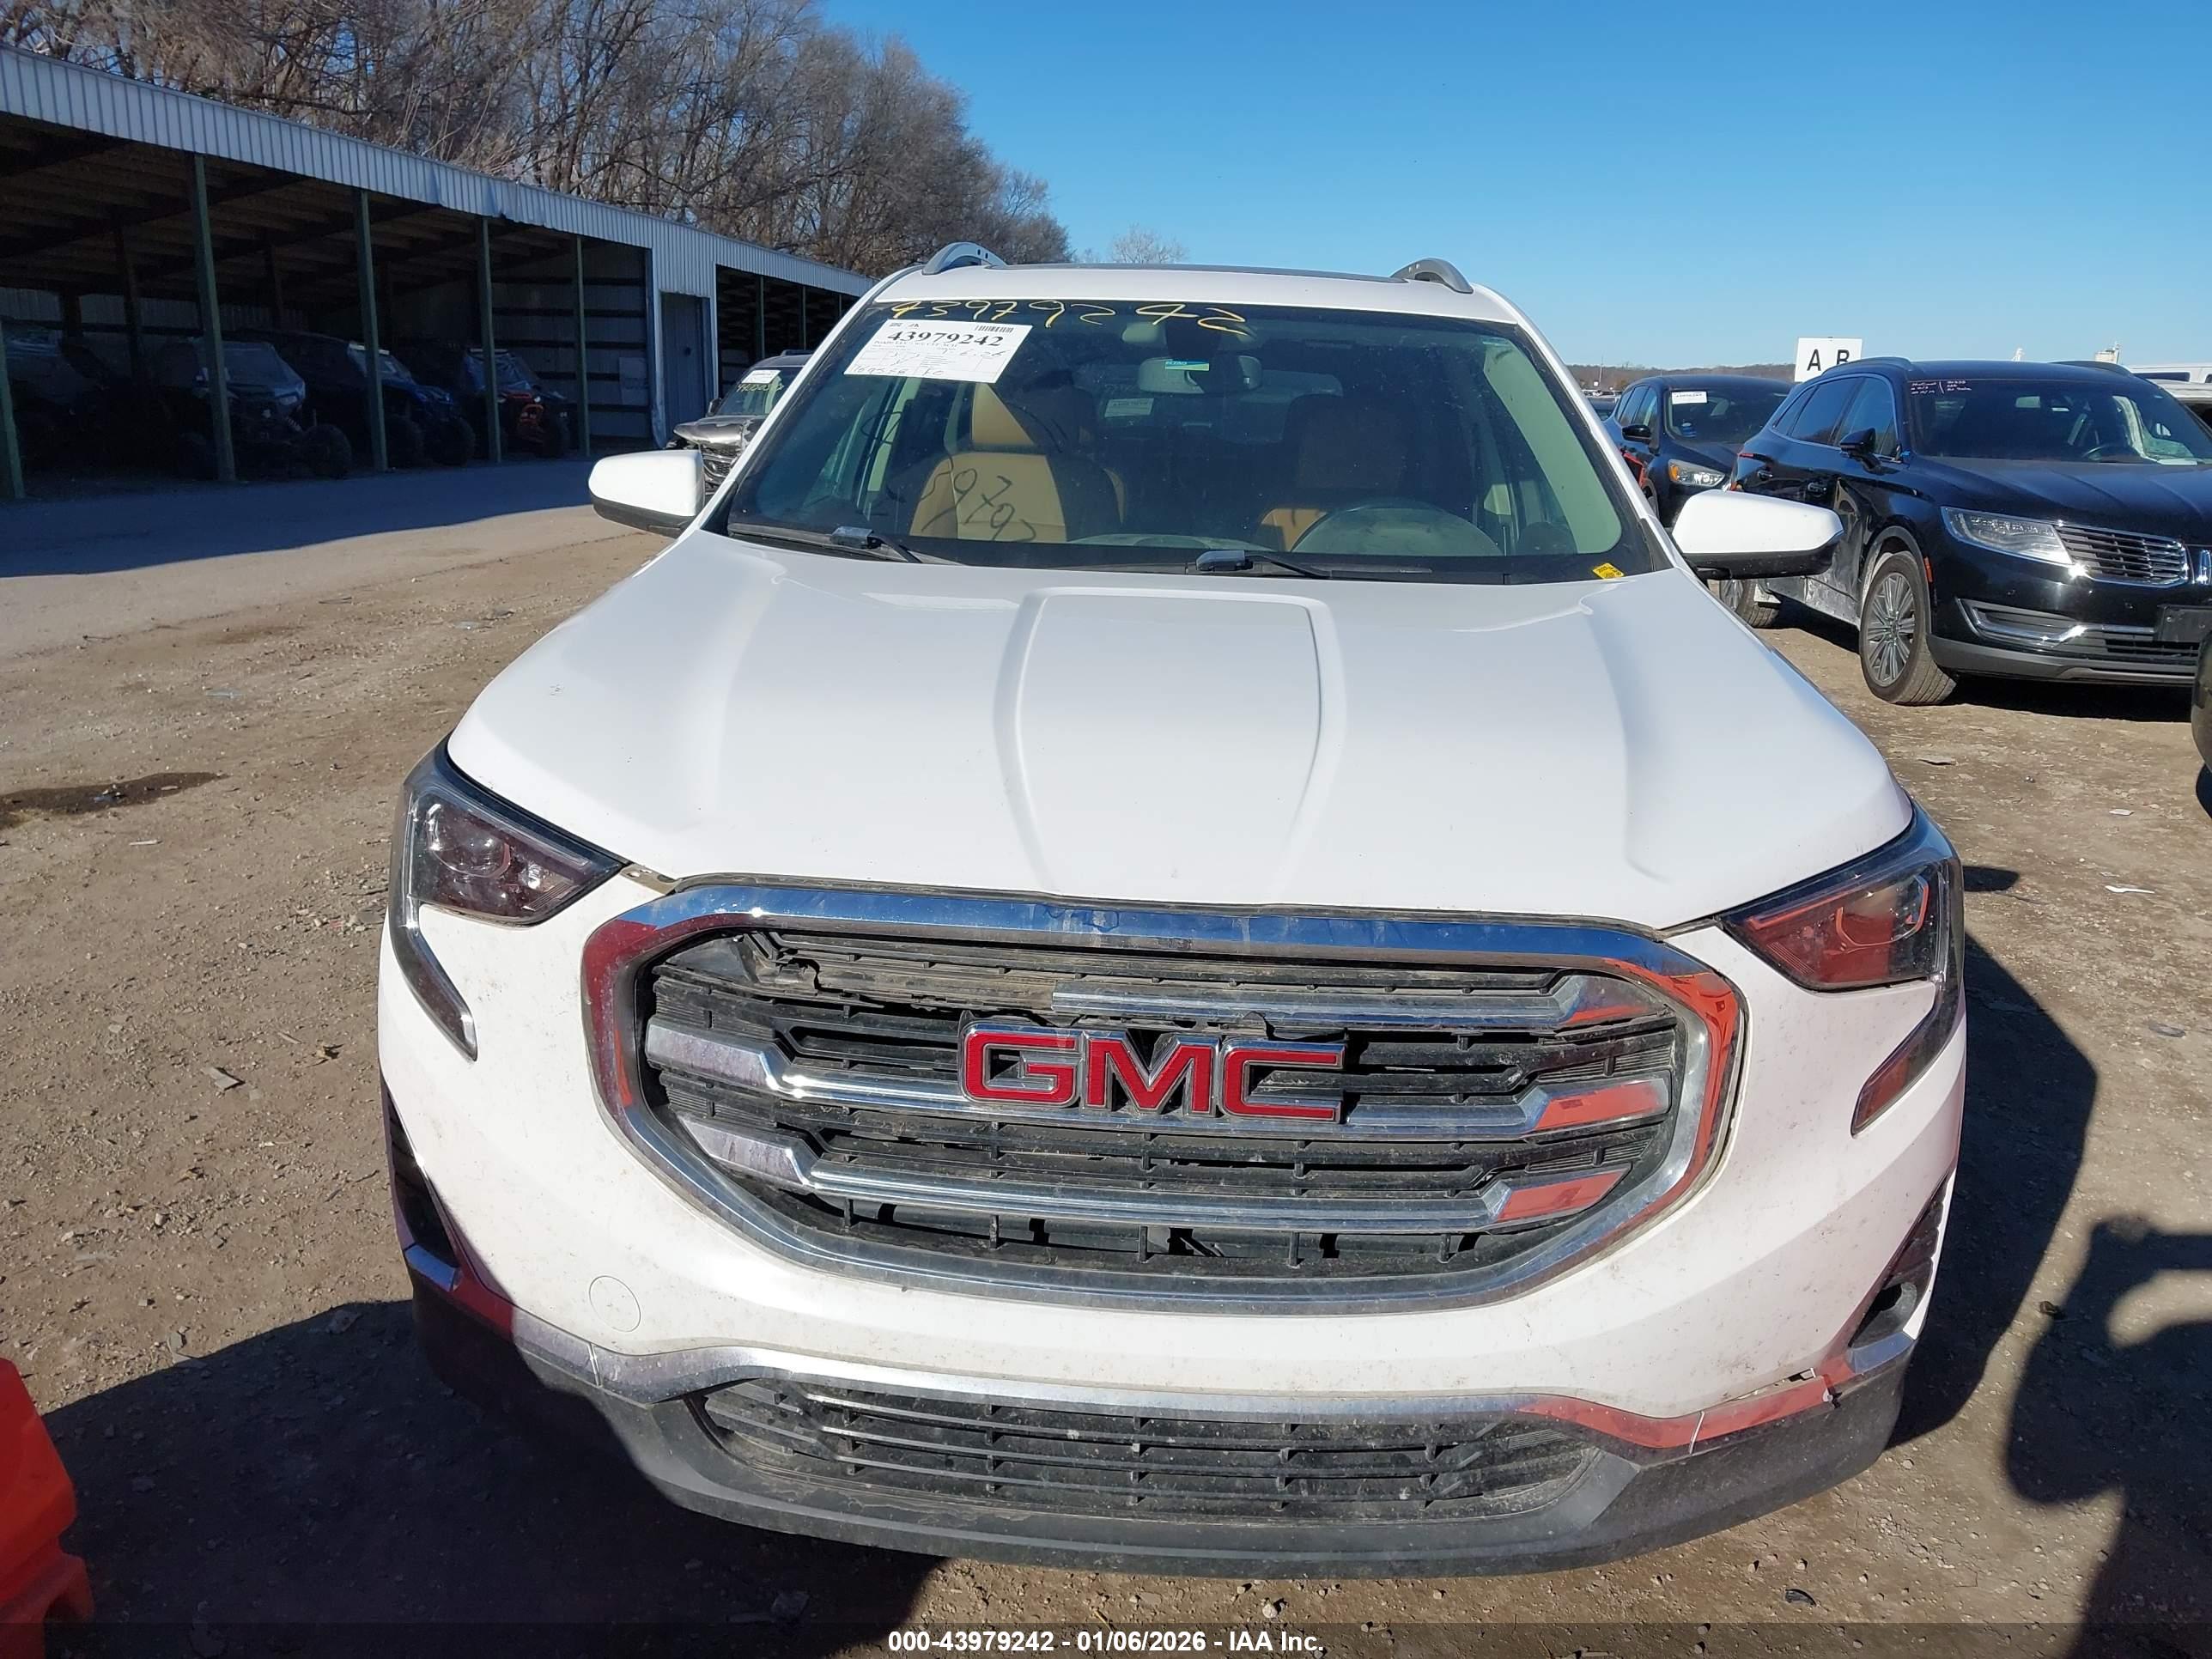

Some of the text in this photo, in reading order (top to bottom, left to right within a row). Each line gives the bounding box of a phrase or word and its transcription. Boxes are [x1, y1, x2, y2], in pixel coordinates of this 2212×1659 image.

[887, 331, 1004, 347] 43979242
[1807, 349, 1821, 371] A
[958, 1022, 1346, 1123] GMC
